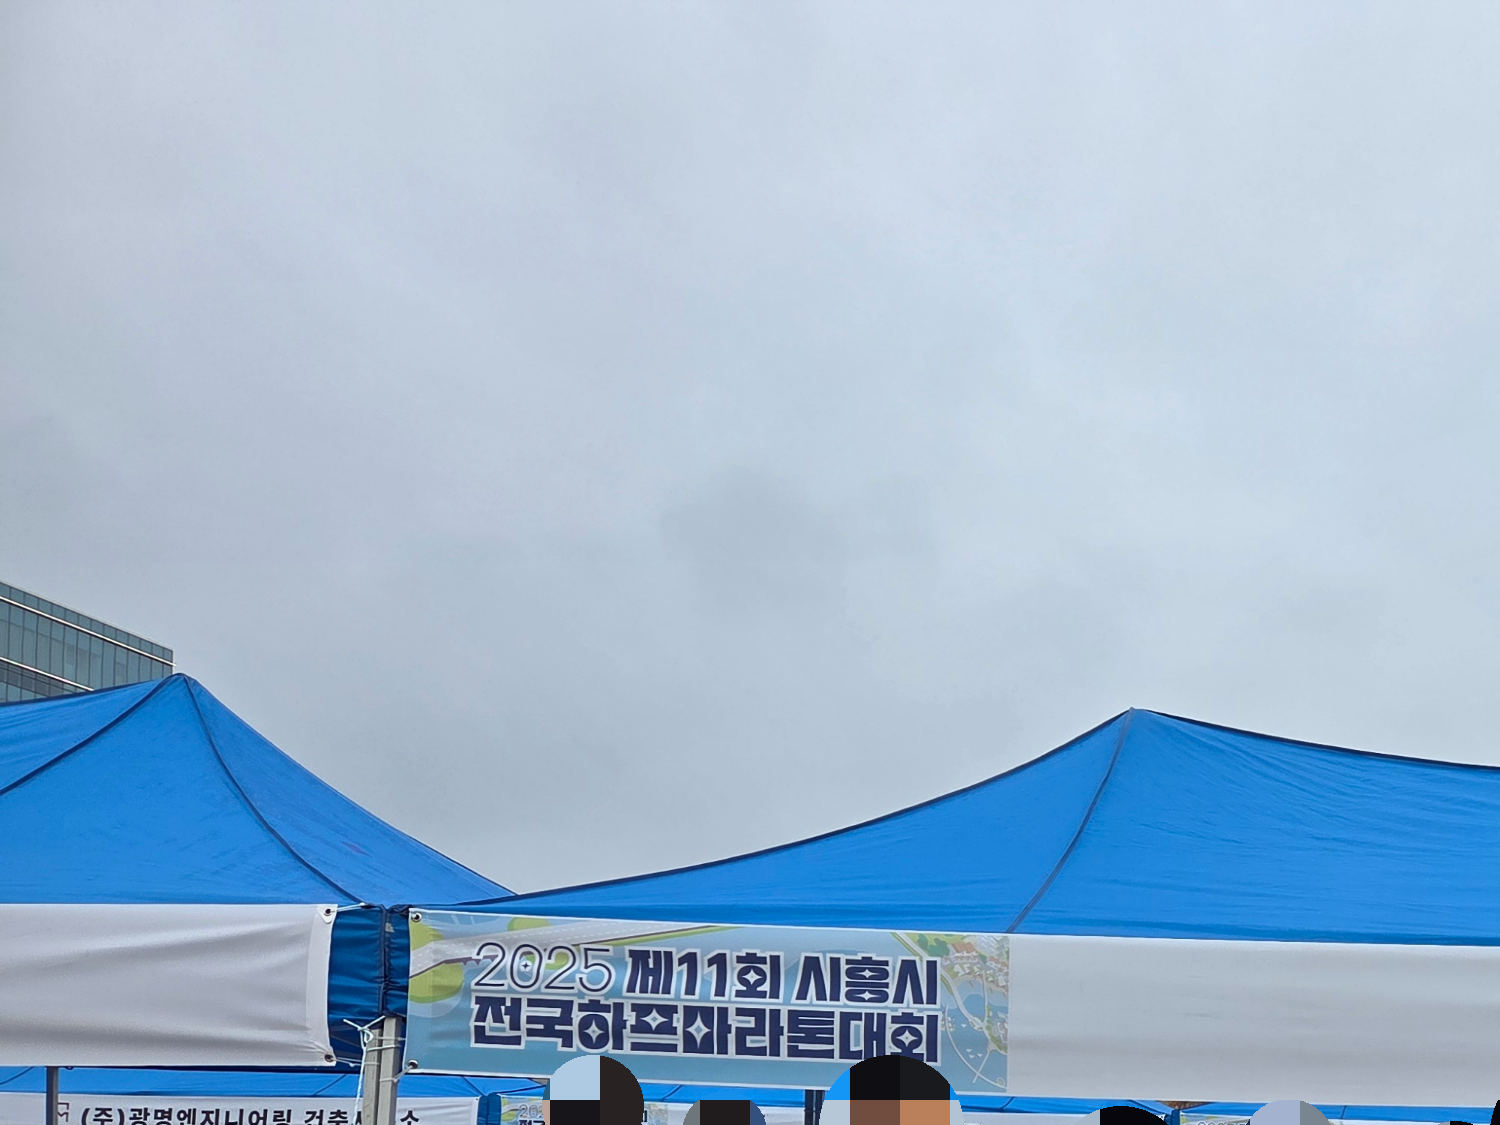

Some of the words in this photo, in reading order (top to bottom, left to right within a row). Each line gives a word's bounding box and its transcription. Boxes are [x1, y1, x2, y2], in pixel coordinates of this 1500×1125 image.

[473, 941, 613, 993] 2025
[625, 948, 782, 999] 제11회
[795, 954, 938, 1006] 시흥시
[473, 994, 939, 1063] 전국하프마라톤대회
